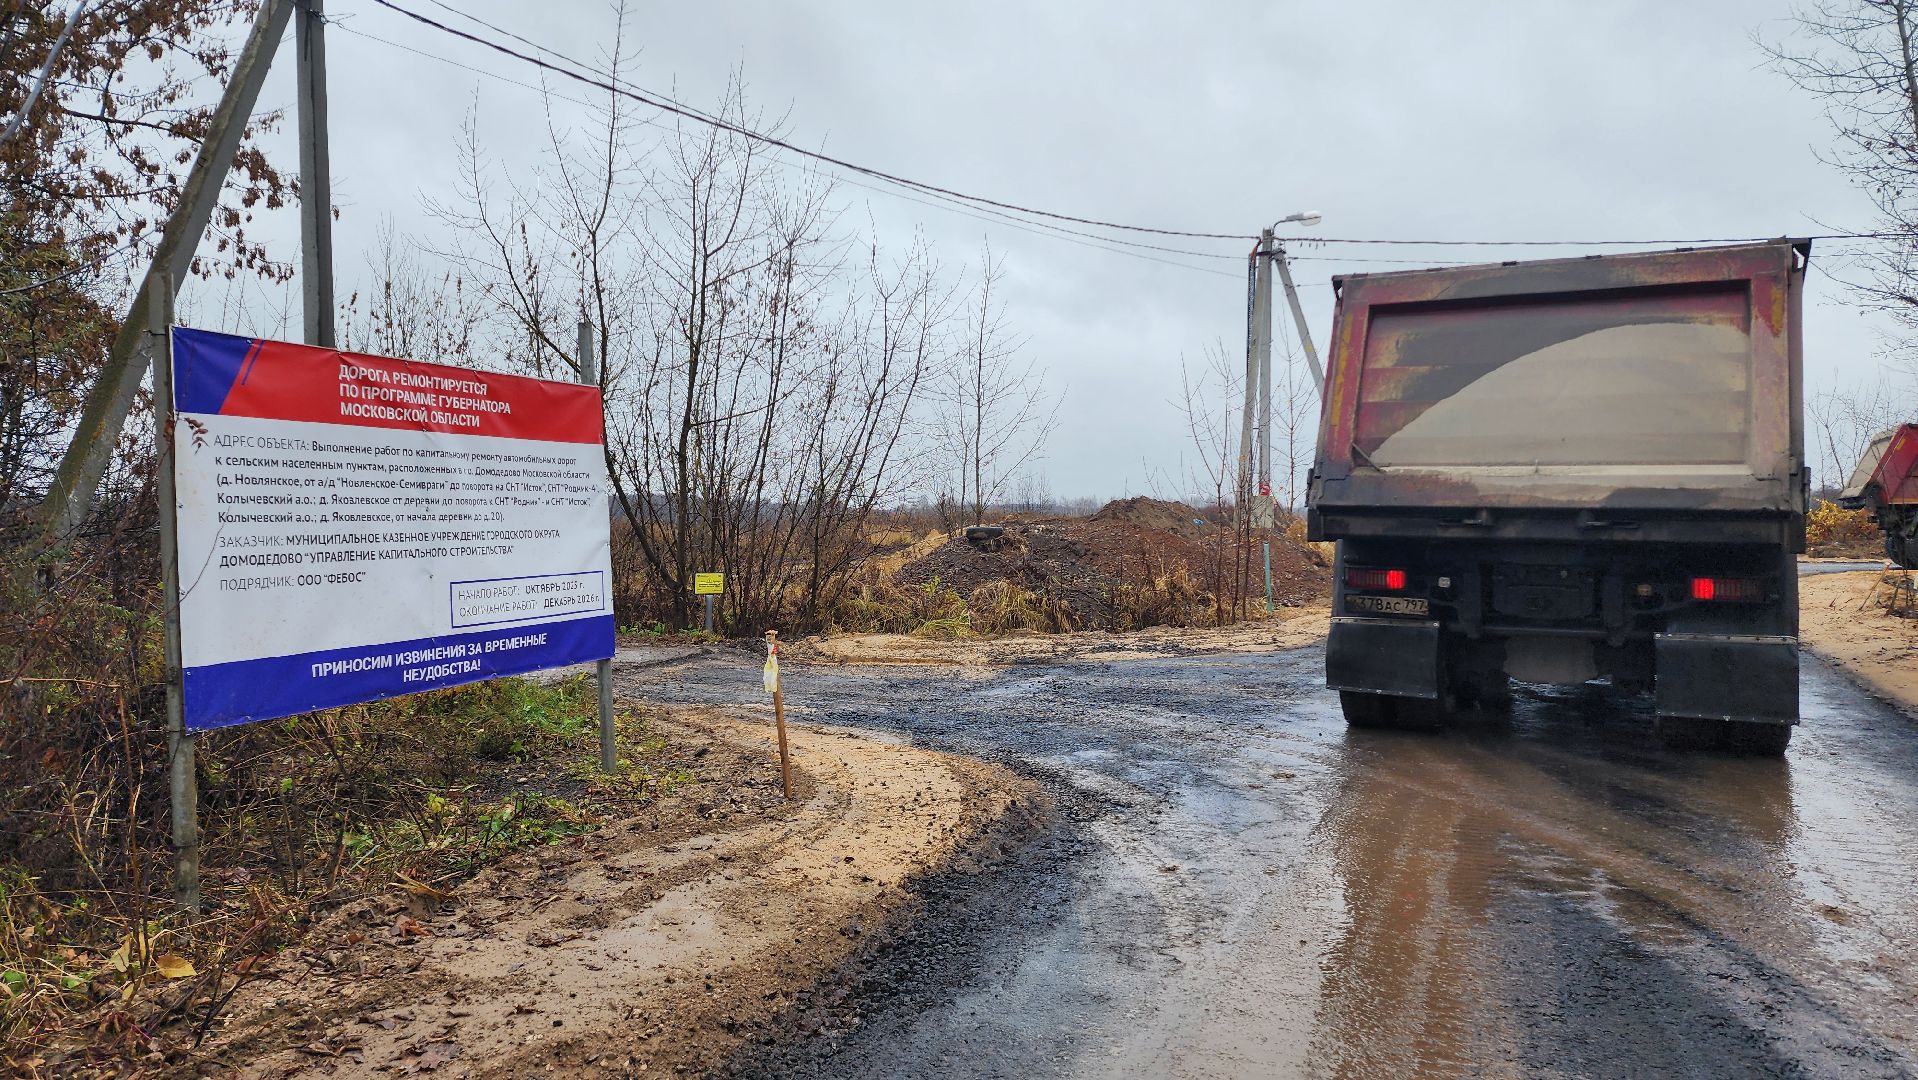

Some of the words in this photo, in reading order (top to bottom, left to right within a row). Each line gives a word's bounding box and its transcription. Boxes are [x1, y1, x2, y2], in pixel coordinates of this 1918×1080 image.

[339, 364, 390, 384] ДОРОГА
[393, 372, 488, 396] РЕМОНТИРУЕТСЯ
[339, 384, 358, 398] ПО
[362, 386, 437, 408] ПРОГРАММЕ
[439, 395, 511, 415] ГУБЕРНАТОРА
[340, 402, 428, 423] МОСКОВСКОЙ
[430, 410, 480, 428] ОБЛАСТИ
[214, 434, 254, 448] АДРЕС
[257, 436, 310, 450] ОБЪЕКТА:
[312, 440, 372, 455] Выполнение
[374, 446, 401, 458] работ
[402, 448, 413, 456] по
[416, 448, 470, 462] капитальному
[472, 453, 502, 464] ремонту
[504, 455, 556, 464] автомобильных
[215, 456, 222, 466] к
[226, 456, 279, 468] сельским
[282, 459, 343, 470] населенным
[346, 462, 387, 474] пунктам,
[389, 464, 458, 475] расположенных
[475, 466, 521, 478] Домодедово
[522, 469, 562, 478] Московской
[562, 470, 590, 479] области
[216, 473, 232, 488] (д.
[235, 474, 302, 488] Новлянское,
[304, 478, 316, 487] от
[318, 477, 336, 488] а/д
[450, 482, 460, 492] до
[461, 483, 494, 492] поворота
[506, 482, 520, 492] СНТ
[548, 484, 560, 493] СНТ
[217, 492, 293, 504] Колычевский
[319, 496, 328, 506] д.
[331, 494, 390, 505] Яковлевское
[404, 497, 440, 508] деревни
[442, 498, 453, 506] до
[455, 498, 488, 507] поворота
[494, 496, 509, 506] СНТ
[551, 498, 564, 506] СНТ
[218, 512, 293, 523] Колычевский
[320, 514, 330, 524] д.
[332, 512, 394, 524] Яковлевское,
[407, 514, 436, 522] начала
[438, 514, 472, 524] деревни
[220, 535, 284, 548] ЗАКАЗЧИК:
[286, 533, 380, 546] МУНИЦИПАЛЬНОЕ
[382, 532, 430, 543] КАЗЕННОЕ
[431, 531, 486, 542] УЧРЕЖДЕНИЕ
[487, 530, 533, 540] ГОРОДСКОГО
[534, 529, 560, 539] ОКРУГА
[220, 553, 303, 568] ДОМОДЕДОВО
[305, 550, 376, 563] "УПРАВЛЕНИЕ
[378, 547, 448, 560] КАПИТАЛЬНОГО
[220, 576, 295, 592] ПОДРЯДЧИК:
[298, 574, 322, 586] ООО
[324, 572, 366, 585] "ФЕБОС"
[458, 588, 492, 600] НАЧАЛО
[526, 582, 560, 594] ОКТЯБРЬ
[544, 595, 576, 609] ДЕКАБРЬ
[577, 594, 594, 604] 2026
[1404, 600, 1424, 610] 797
[312, 654, 392, 678] ПРИНОСИМ
[395, 644, 466, 666] ИЗВИНЕНИЯ
[468, 641, 482, 655] ЗА
[484, 632, 548, 653] ВРЕМЕННЫЕ
[403, 658, 481, 682] НЕУДОБСТВА!
